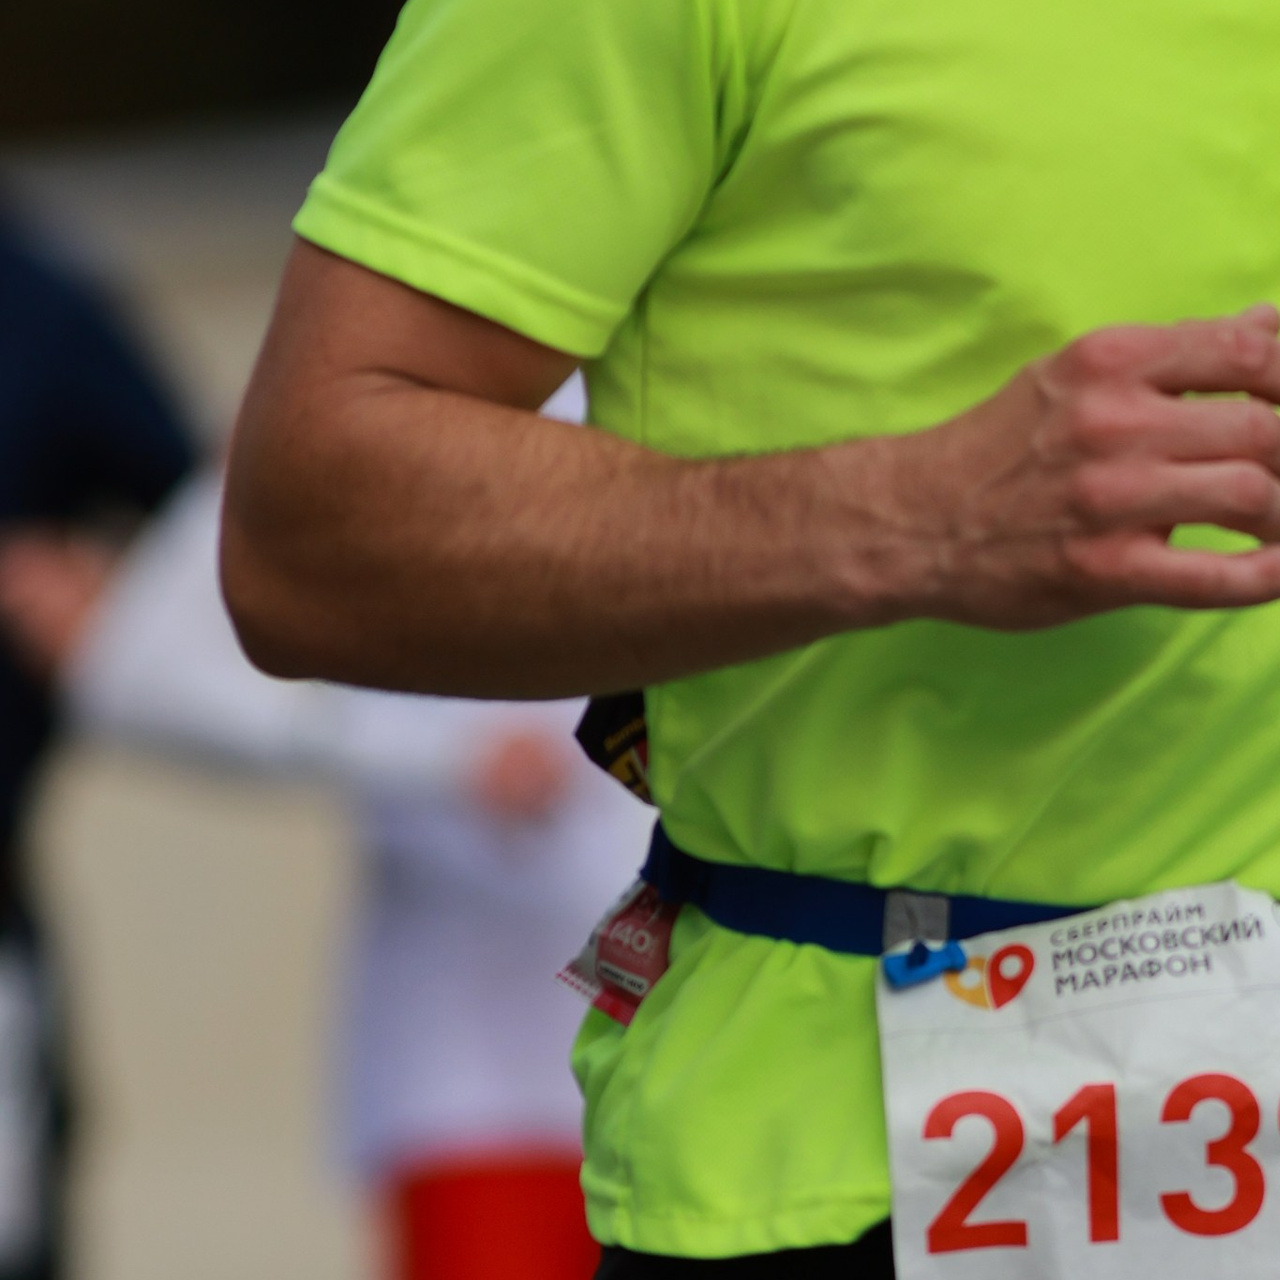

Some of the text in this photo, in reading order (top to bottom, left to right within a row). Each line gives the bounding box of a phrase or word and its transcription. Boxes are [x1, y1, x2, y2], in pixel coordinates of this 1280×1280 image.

[1050, 902, 1205, 946] СБЕРПРАЙМ
[1052, 914, 1264, 972] МОСКОВСКИЙ
[1055, 952, 1213, 997] МАРАФОН
